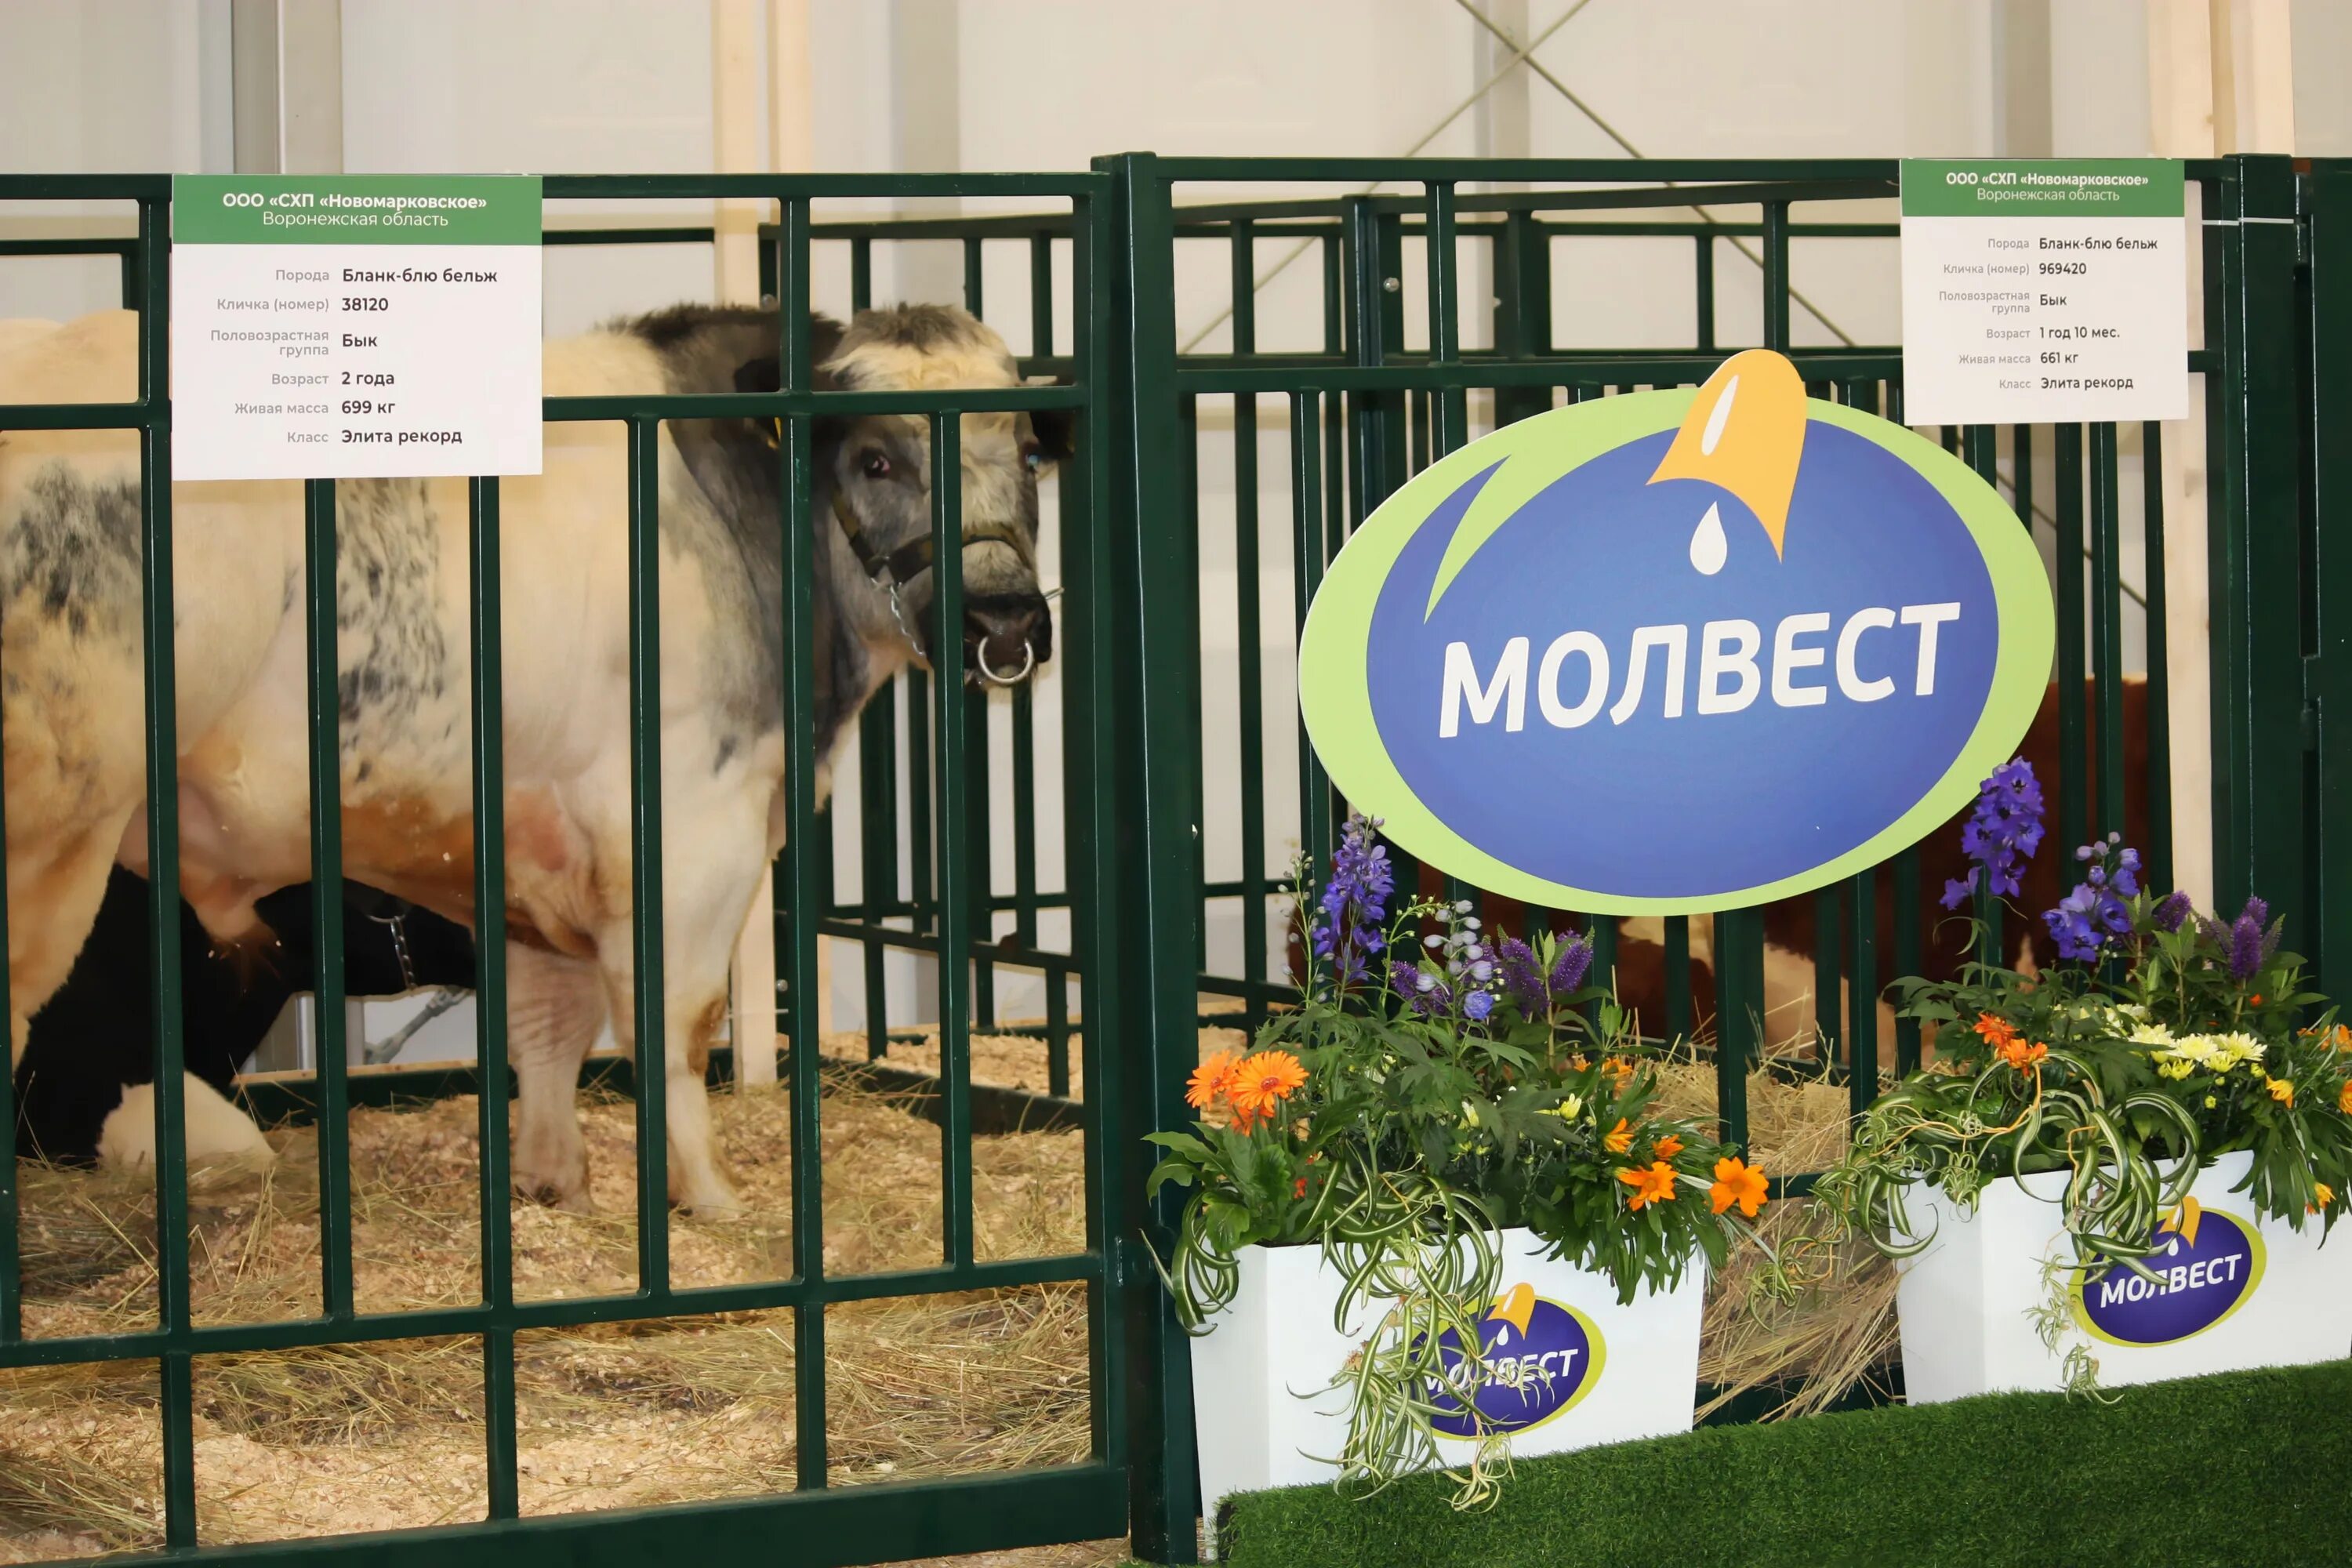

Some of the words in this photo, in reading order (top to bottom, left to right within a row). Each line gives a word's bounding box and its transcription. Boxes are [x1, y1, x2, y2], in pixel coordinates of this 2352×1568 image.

[1947, 172, 1978, 184] ООО
[1982, 172, 2016, 184] «СХП
[2021, 173, 2148, 187] «Новомарковское»
[1977, 188, 2065, 202] Воронежская
[2069, 189, 2119, 200] область
[223, 194, 264, 207] ООО
[270, 194, 314, 207] «СХП
[320, 194, 486, 211] «Новомарковское»
[263, 212, 377, 228] Воронежская
[383, 211, 448, 226] область
[1988, 238, 2029, 250] Порода
[2040, 237, 2111, 249] Бланк-блю
[2116, 237, 2157, 249] бельж
[276, 270, 329, 283] Порода
[343, 268, 437, 281] Бланк-блю
[443, 268, 497, 281] бельж
[1944, 264, 1984, 274] Кличка
[1987, 263, 2029, 275] (номер)
[2039, 263, 2086, 274] 969420
[1940, 292, 2029, 303] Половозрастная
[2041, 294, 2066, 305] Бык
[218, 299, 269, 310] Кличка
[274, 299, 328, 312] (номер)
[343, 298, 388, 310] 38120
[1992, 306, 2030, 315] группа
[211, 330, 328, 343] Половозрастная
[1987, 329, 2031, 340] Возраст
[2040, 327, 2044, 338] 1
[2049, 329, 2071, 339] год
[2074, 327, 2087, 338] 10
[2092, 329, 2119, 338] мес.
[343, 334, 377, 347] Бык
[280, 347, 328, 358] группа
[1959, 354, 1994, 364] Живая
[2041, 352, 2060, 363] 661
[2065, 354, 2078, 363] кг
[272, 374, 328, 387] Возраст
[342, 372, 350, 384] 2
[357, 375, 394, 387] года
[2000, 379, 2031, 389] Класс
[2042, 378, 2079, 389] Элита
[2085, 379, 2133, 390] рекорд
[235, 404, 281, 414] Живая
[342, 401, 372, 414] 699
[378, 404, 395, 413] кг
[288, 432, 328, 442] Класс
[342, 430, 392, 443] Элита
[399, 432, 462, 445] рекорд
[1439, 602, 1961, 739] МОЛВЕСТ
